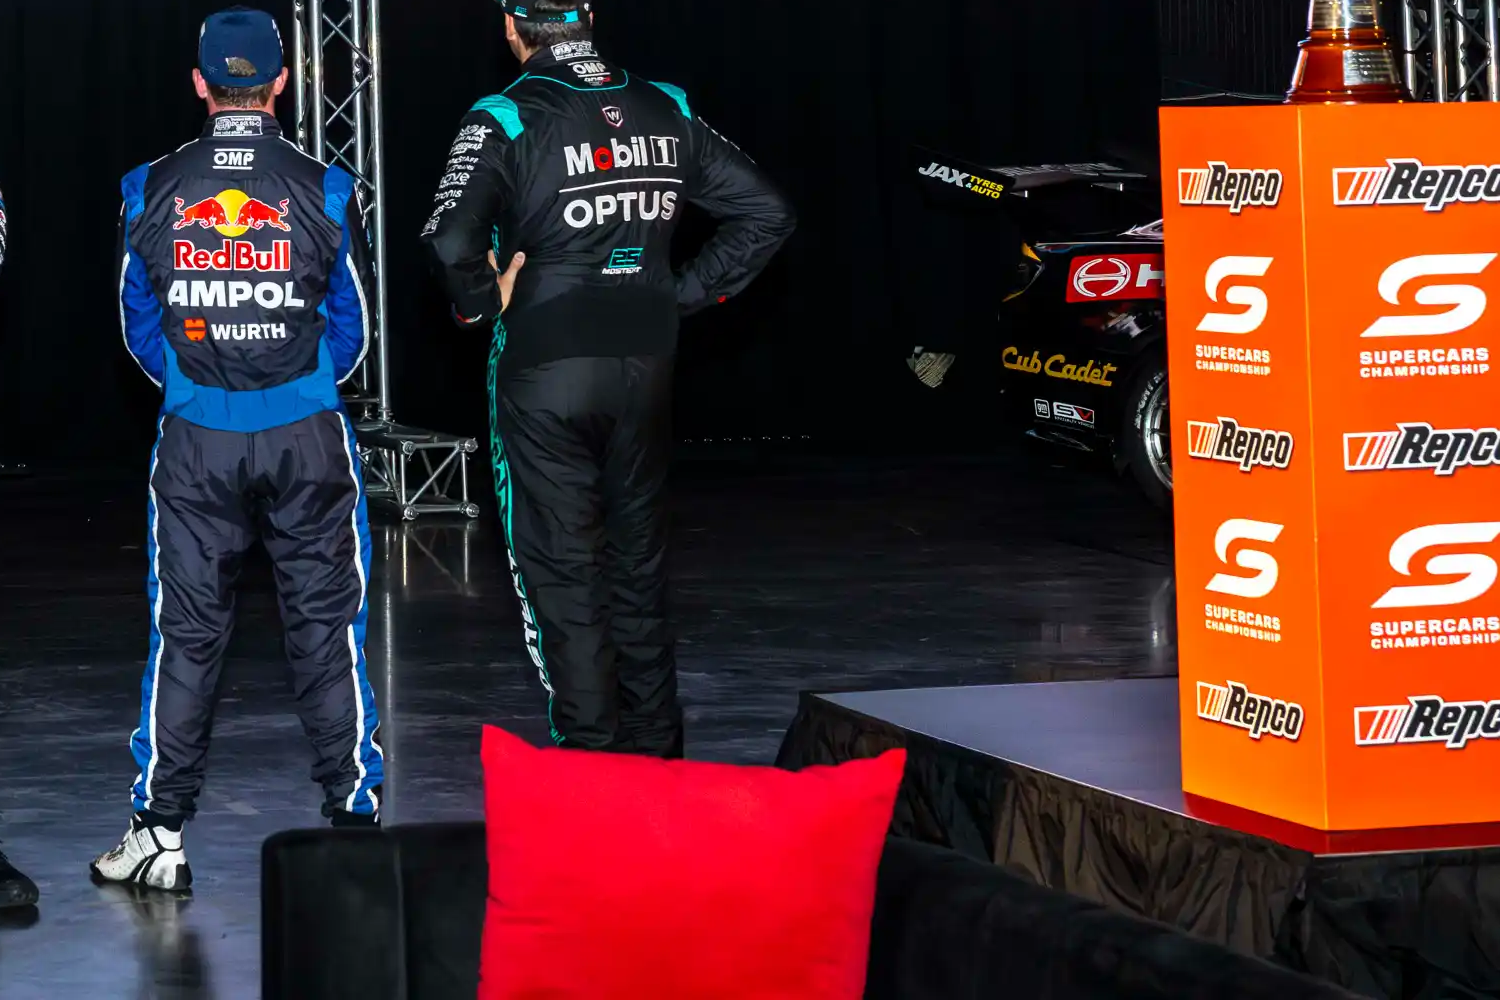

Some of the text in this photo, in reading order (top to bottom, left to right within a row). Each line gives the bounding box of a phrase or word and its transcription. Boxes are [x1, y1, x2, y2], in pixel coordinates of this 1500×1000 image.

[572, 62, 606, 74] OMP
[213, 151, 254, 165] OMP
[564, 136, 674, 176] Mobil 1
[918, 162, 970, 187] JAX
[970, 175, 1004, 192] TYRES
[971, 184, 1000, 199] AUTO
[1207, 161, 1283, 213] Repco
[563, 191, 677, 228] OPTUS
[173, 239, 291, 272] Red Bull
[168, 280, 305, 308] AMPOL
[211, 322, 286, 340] WÜRTH
[1002, 346, 1117, 386] Cub Cadet
[1196, 344, 1270, 364] SUPERCARS
[1359, 347, 1490, 366] SUPERCARS
[1196, 360, 1271, 376] CHAMPIONSHIP
[1359, 363, 1490, 378] CHAMPIONSHIP
[1214, 416, 1294, 472] Repco
[1388, 422, 1500, 475] Repc
[1205, 603, 1281, 631] SUPERCARS
[1370, 616, 1500, 637] SUPERCARS
[1205, 619, 1282, 643] CHAMPIONSHIP
[1370, 632, 1500, 650] CHAMPIONSHIP
[1223, 680, 1304, 740] Repco
[1398, 695, 1500, 749] Repc
